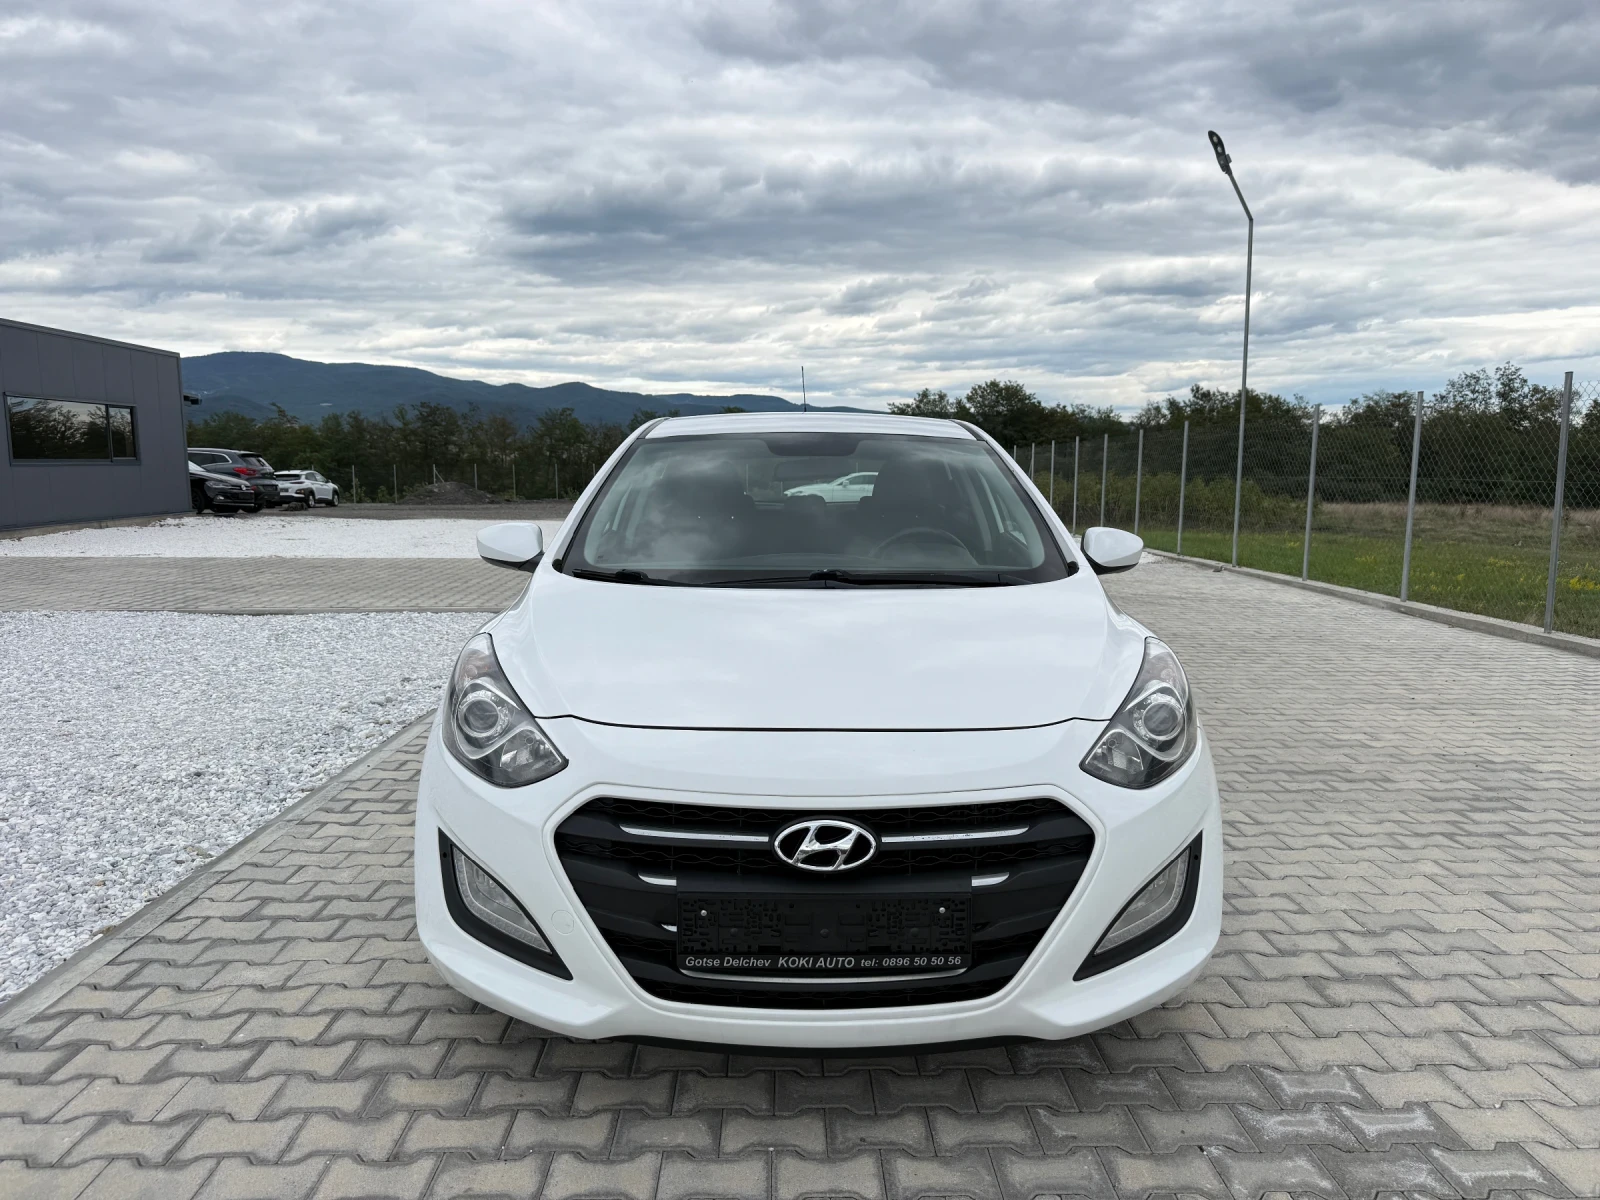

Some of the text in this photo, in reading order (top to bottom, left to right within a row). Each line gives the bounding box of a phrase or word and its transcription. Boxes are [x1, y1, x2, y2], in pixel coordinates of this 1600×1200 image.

[685, 956, 962, 968] Gotse Delchev KOKI AUTO tel: 0896 50 50 56
